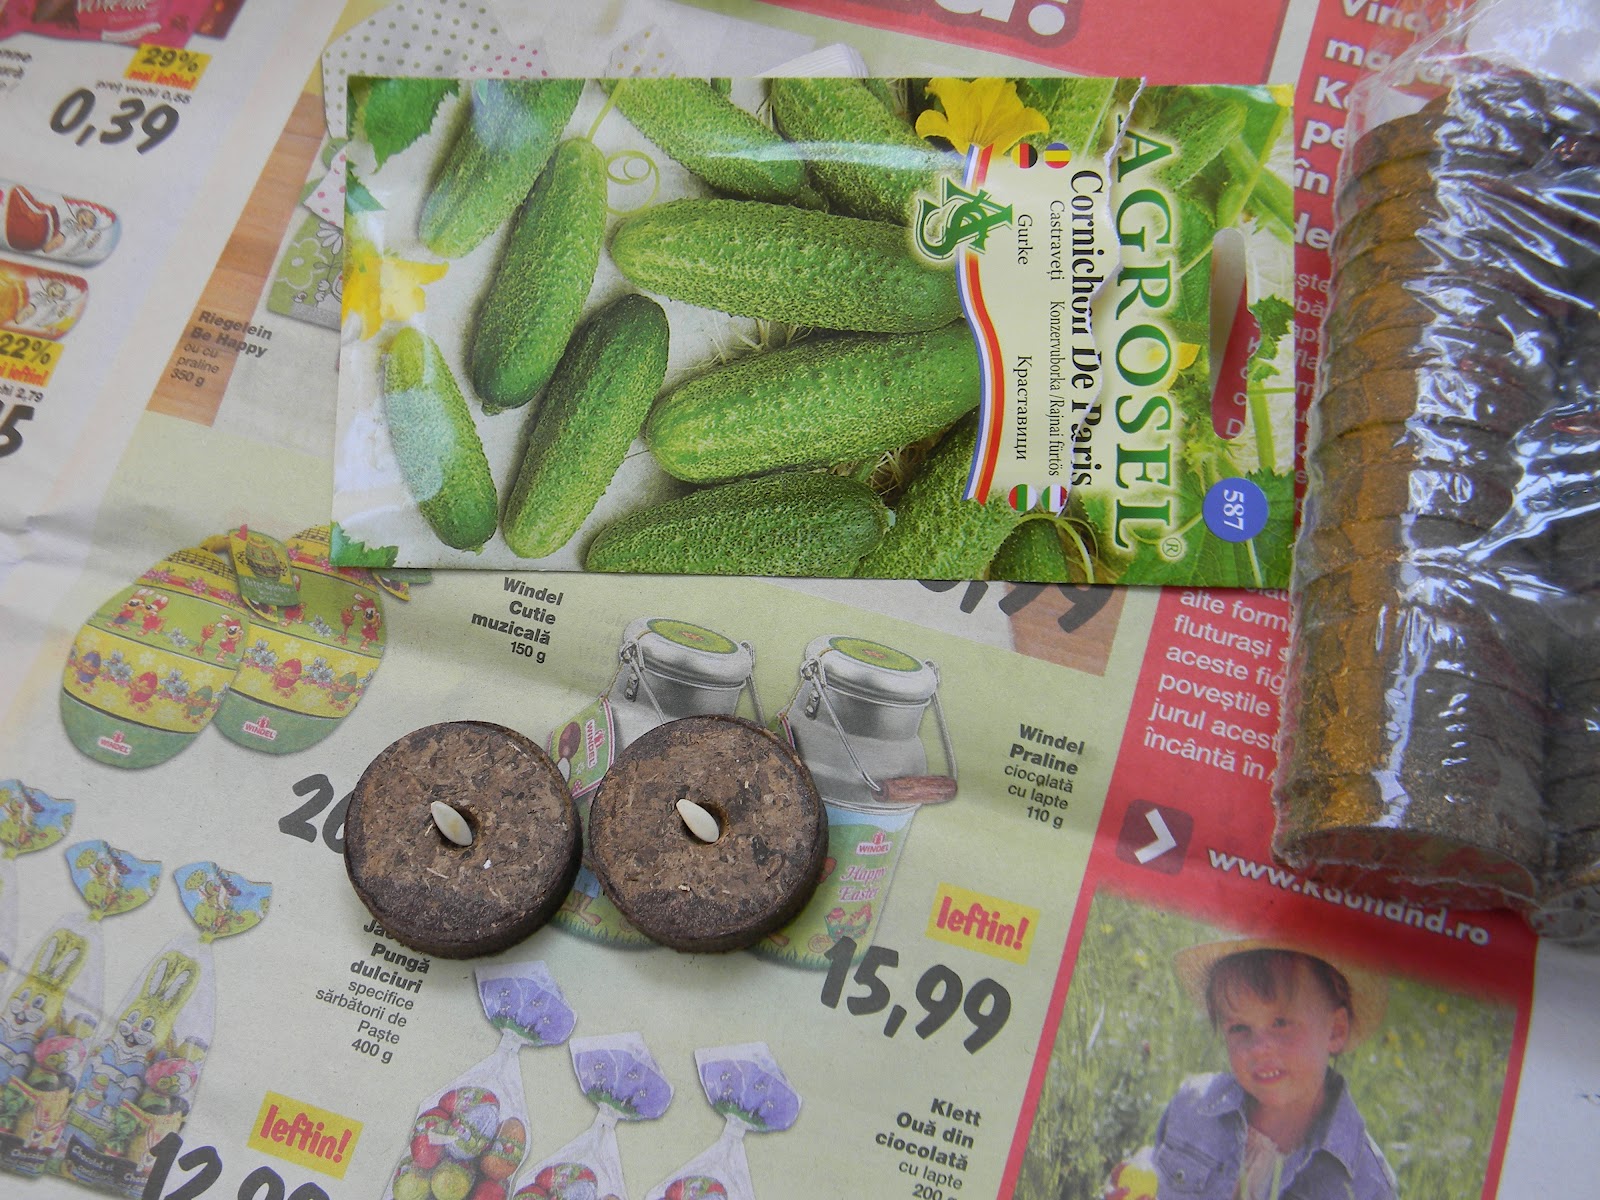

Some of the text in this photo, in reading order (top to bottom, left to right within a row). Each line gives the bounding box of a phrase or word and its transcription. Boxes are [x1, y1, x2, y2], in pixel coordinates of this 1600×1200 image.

[142, 47, 200, 73] 29%
[50, 88, 180, 154] 0,39
[1017, 213, 1034, 266] Gurke
[1046, 200, 1066, 282] Castraveți
[198, 310, 273, 340] Riegelein
[1070, 170, 1105, 487] Cornichon De Paris
[1115, 115, 1174, 549] AGROSEL
[0, 332, 52, 365] 22%
[190, 326, 269, 359] Be Happy
[1049, 300, 1067, 391] Konzervuborka
[170, 368, 205, 388] 350 g
[175, 356, 220, 374] praline
[1013, 355, 1033, 461] Краставици
[1048, 440, 1066, 477] fürtös
[1222, 488, 1245, 532] 587
[503, 576, 565, 606] Windel
[1180, 590, 1226, 615] alte
[509, 600, 557, 625] Cutie
[471, 613, 551, 646] muzicală
[1173, 614, 1273, 660] fluturași
[510, 641, 547, 664] 150 g
[1165, 645, 1249, 681] aceste
[1255, 666, 1287, 696] fig
[1157, 673, 1272, 718] poveștile
[244, 722, 276, 740] WINDEL
[1019, 723, 1086, 756] Windel
[1148, 697, 1281, 753] jurul acest
[99, 737, 129, 754] WINDEL
[586, 721, 597, 766] WINDEL
[1009, 743, 1079, 776] Praline
[1143, 725, 1236, 773] încântă
[1242, 754, 1265, 781] în
[1003, 764, 1074, 794] ciocolată
[1007, 784, 1069, 811] cu lapte
[1026, 805, 1064, 830] 110 g
[859, 844, 890, 854] WINDEL
[840, 865, 887, 886] Happy
[839, 886, 880, 902] Easter
[370, 942, 431, 975] Pungă
[350, 960, 424, 994] dulciuri
[315, 988, 408, 1028] sărbătorii de
[347, 981, 415, 1011] specifice
[820, 935, 1012, 1056] 15,99
[357, 1019, 401, 1045] Paște
[351, 1038, 394, 1065] 400 g
[930, 1098, 982, 1128] Klett
[896, 1112, 975, 1150] Ouă din
[875, 1132, 969, 1172] ciocolată
[898, 1160, 963, 1191] cu lapte
[911, 1183, 943, 1200] 200
